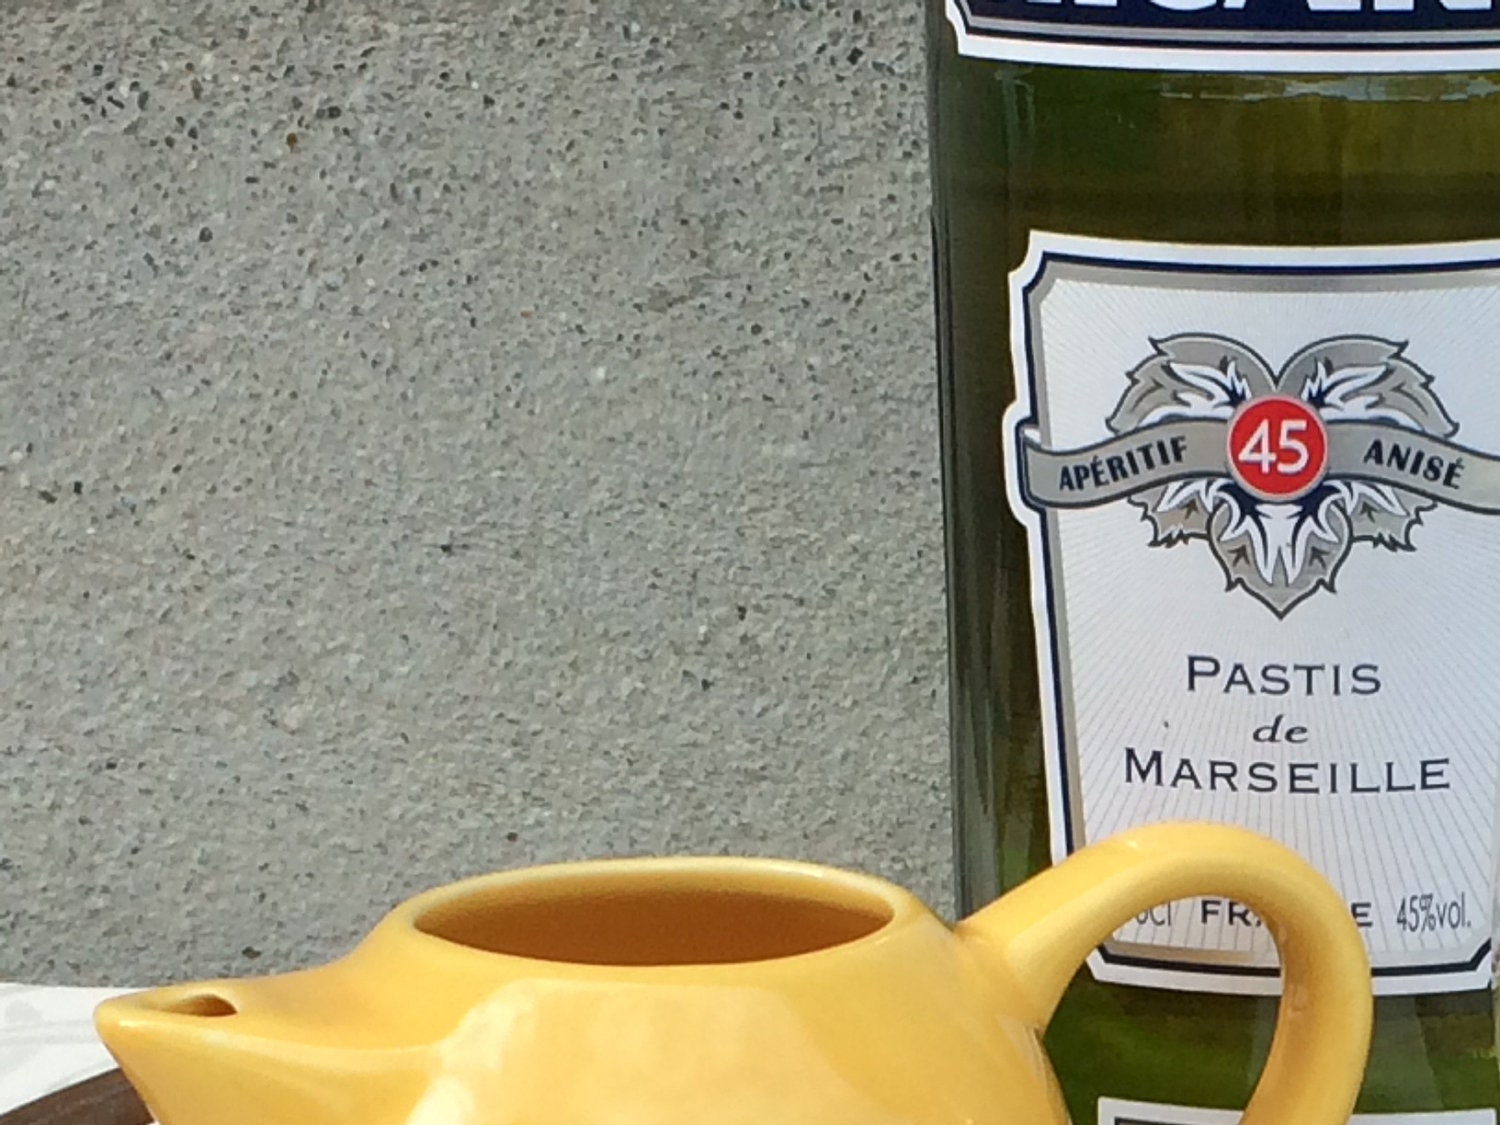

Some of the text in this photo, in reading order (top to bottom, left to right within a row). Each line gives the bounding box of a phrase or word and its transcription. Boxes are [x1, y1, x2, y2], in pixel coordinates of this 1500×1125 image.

[1058, 435, 1189, 491] APÉRITIF
[1238, 418, 1310, 475] 45
[1363, 438, 1466, 491] ANISÉ
[1186, 655, 1383, 697] PASTIS
[1251, 714, 1310, 744] de
[1124, 746, 1451, 795] MARSEILLE
